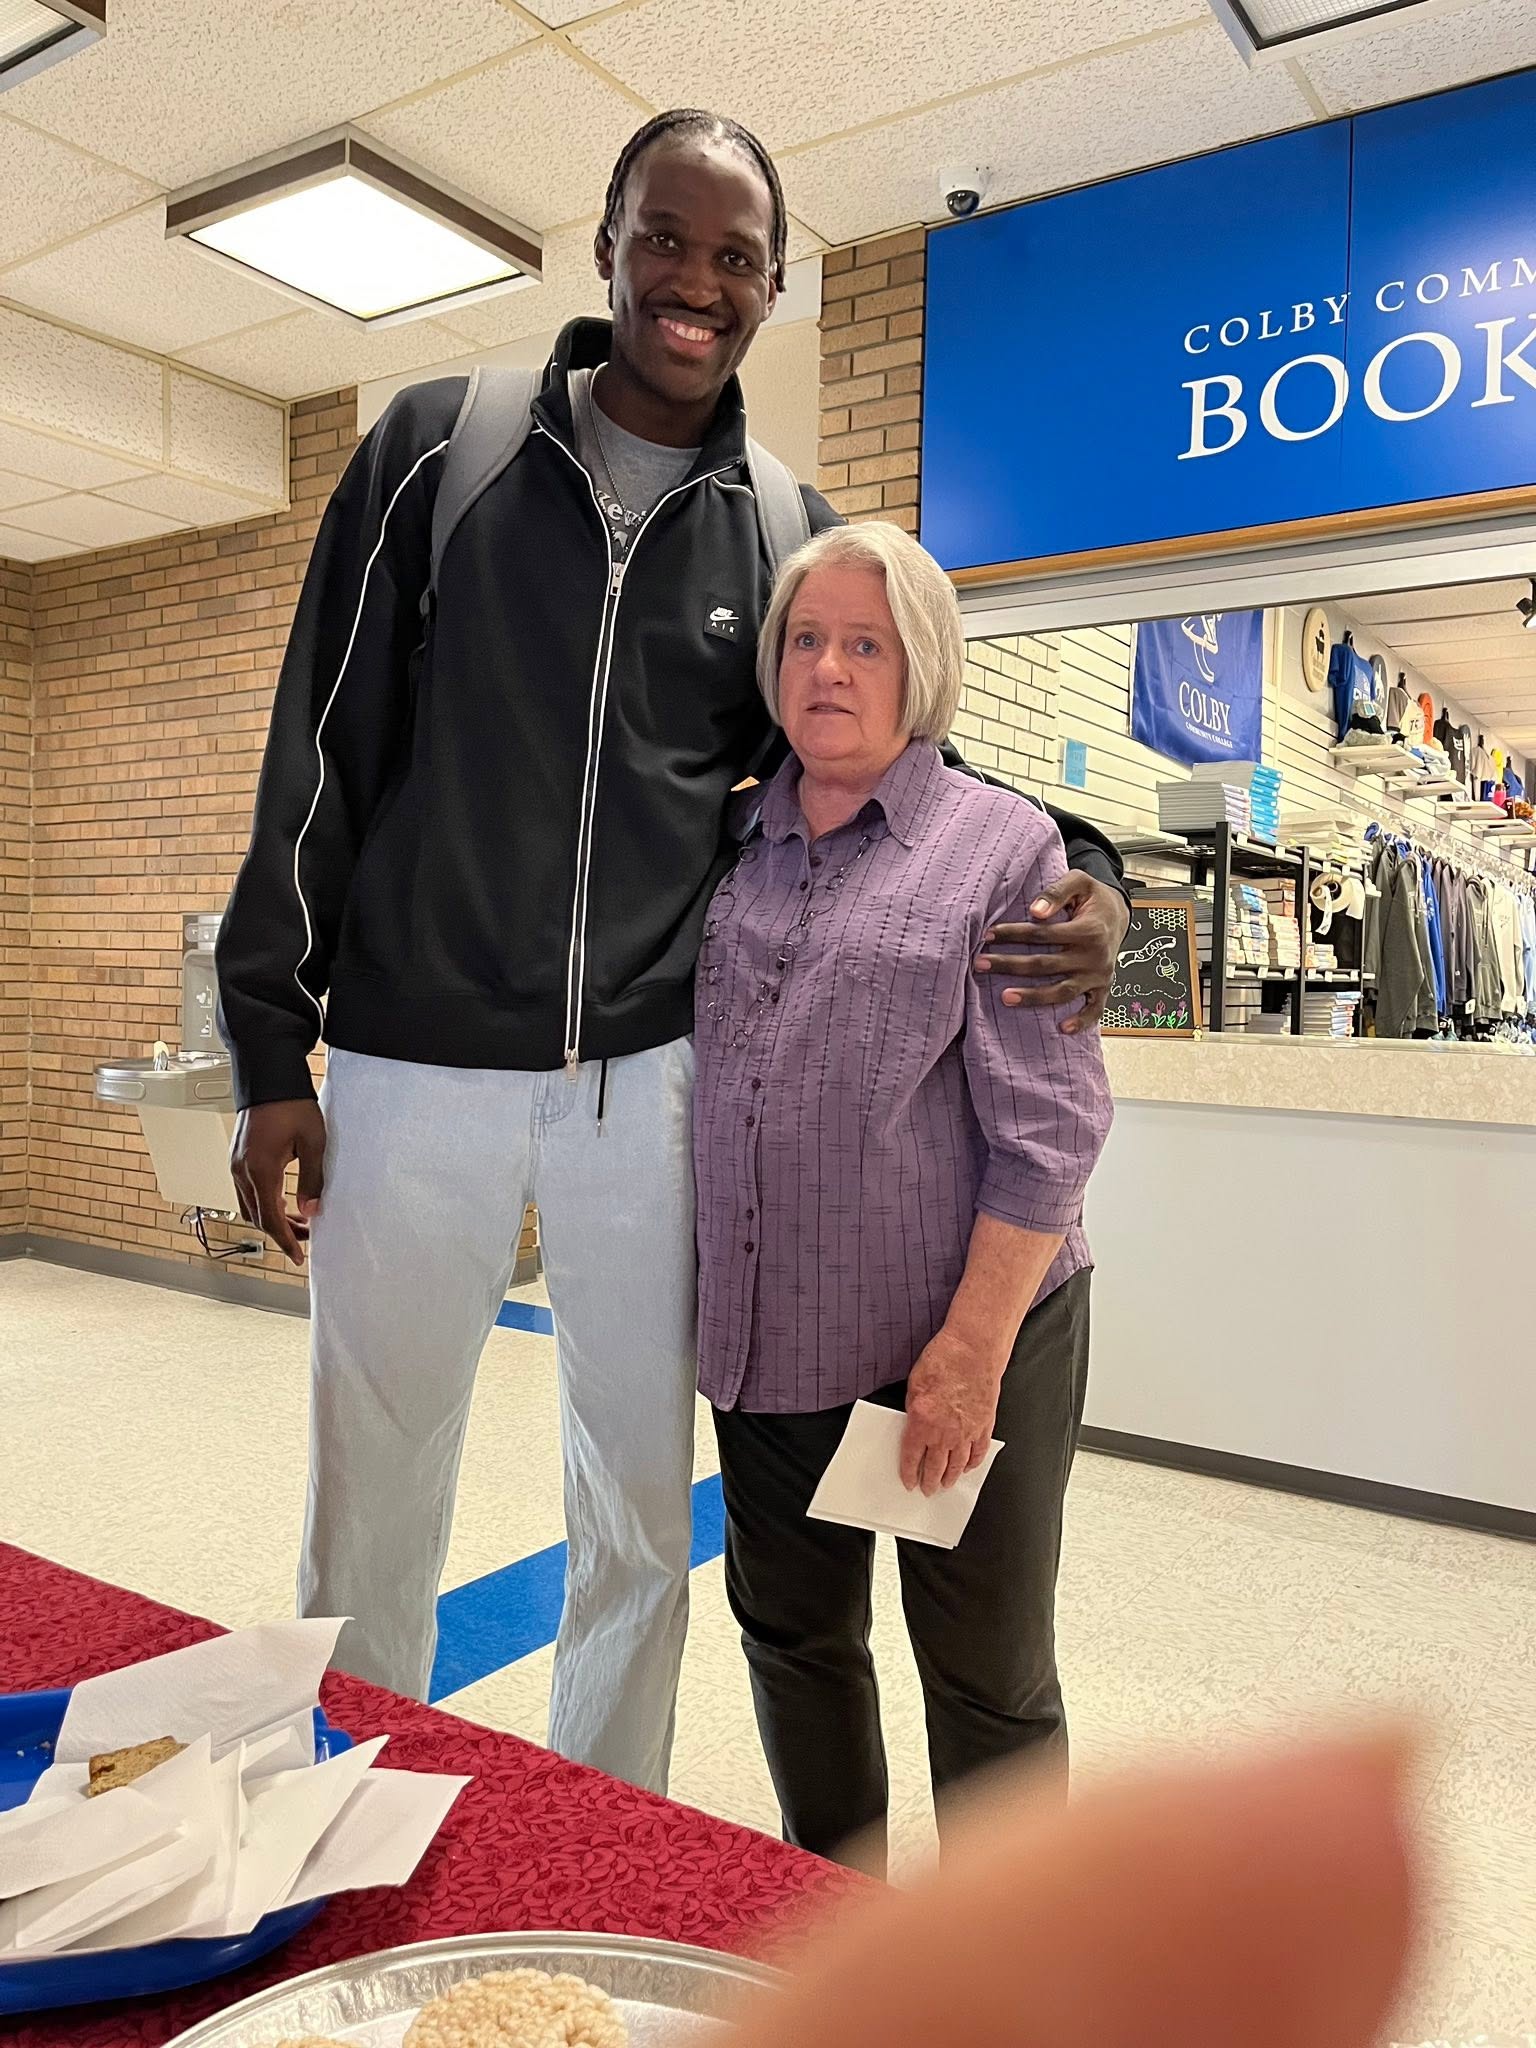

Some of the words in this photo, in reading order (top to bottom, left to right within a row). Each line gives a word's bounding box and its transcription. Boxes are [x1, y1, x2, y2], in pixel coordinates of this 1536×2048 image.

[1183, 291, 1351, 354] COLBY
[1177, 312, 1536, 460] BOOK
[711, 621, 735, 634] AIR
[1179, 681, 1231, 736] COLBY
[1145, 940, 1163, 957] CAN
